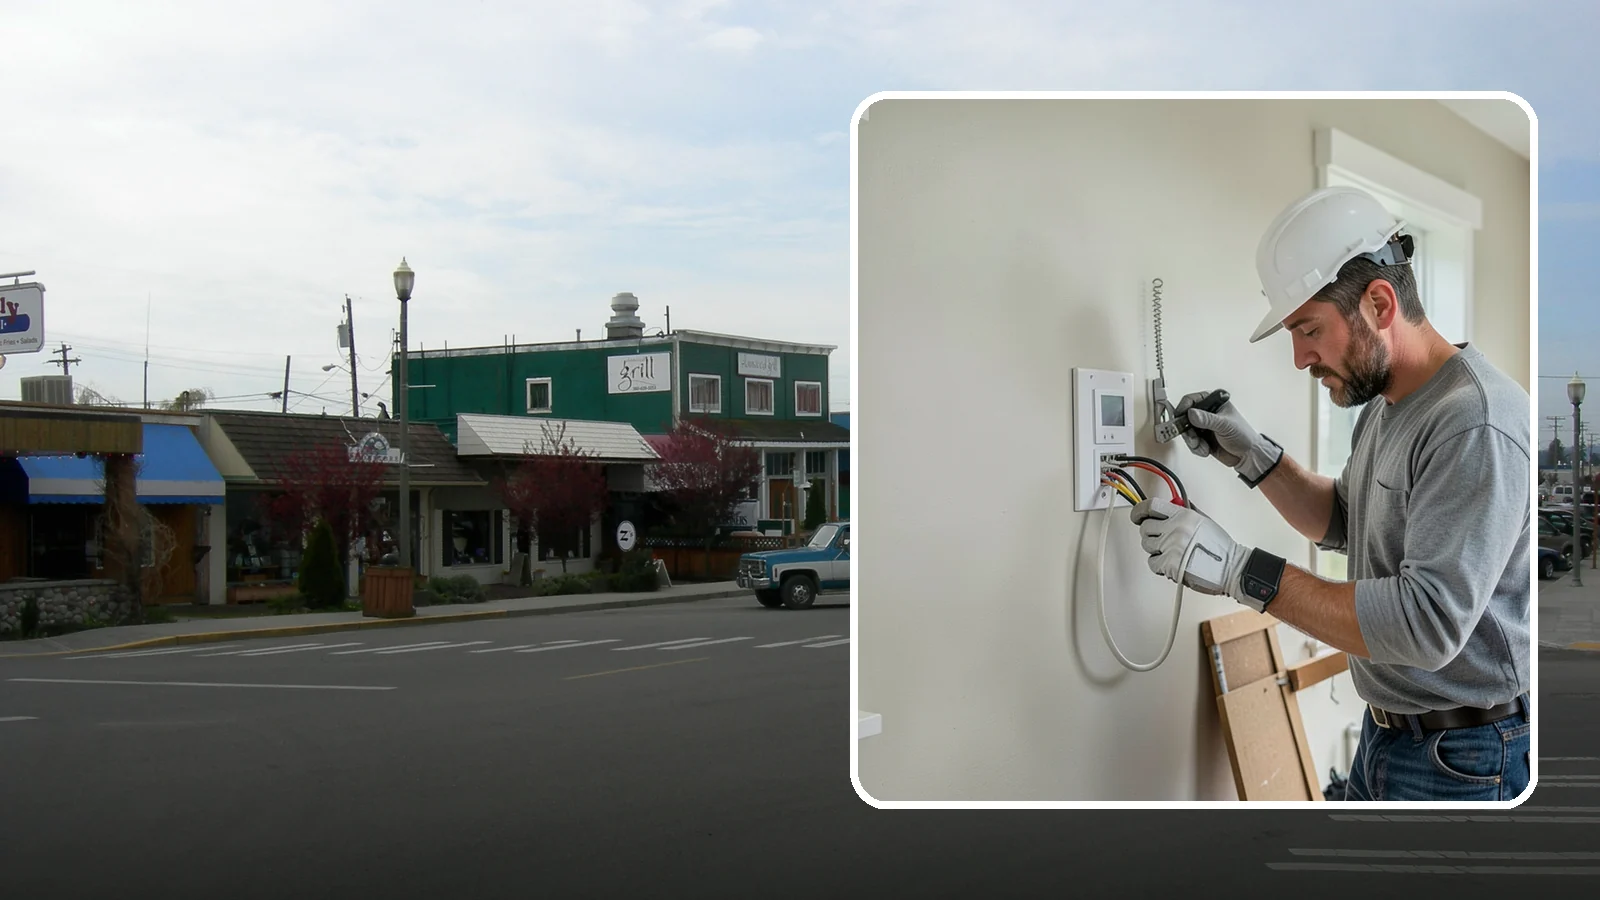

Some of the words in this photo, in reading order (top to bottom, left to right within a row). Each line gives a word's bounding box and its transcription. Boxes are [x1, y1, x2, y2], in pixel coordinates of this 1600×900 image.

[20, 337, 38, 345] Salads
[618, 356, 655, 392] grill
[620, 530, 634, 542] Z's
